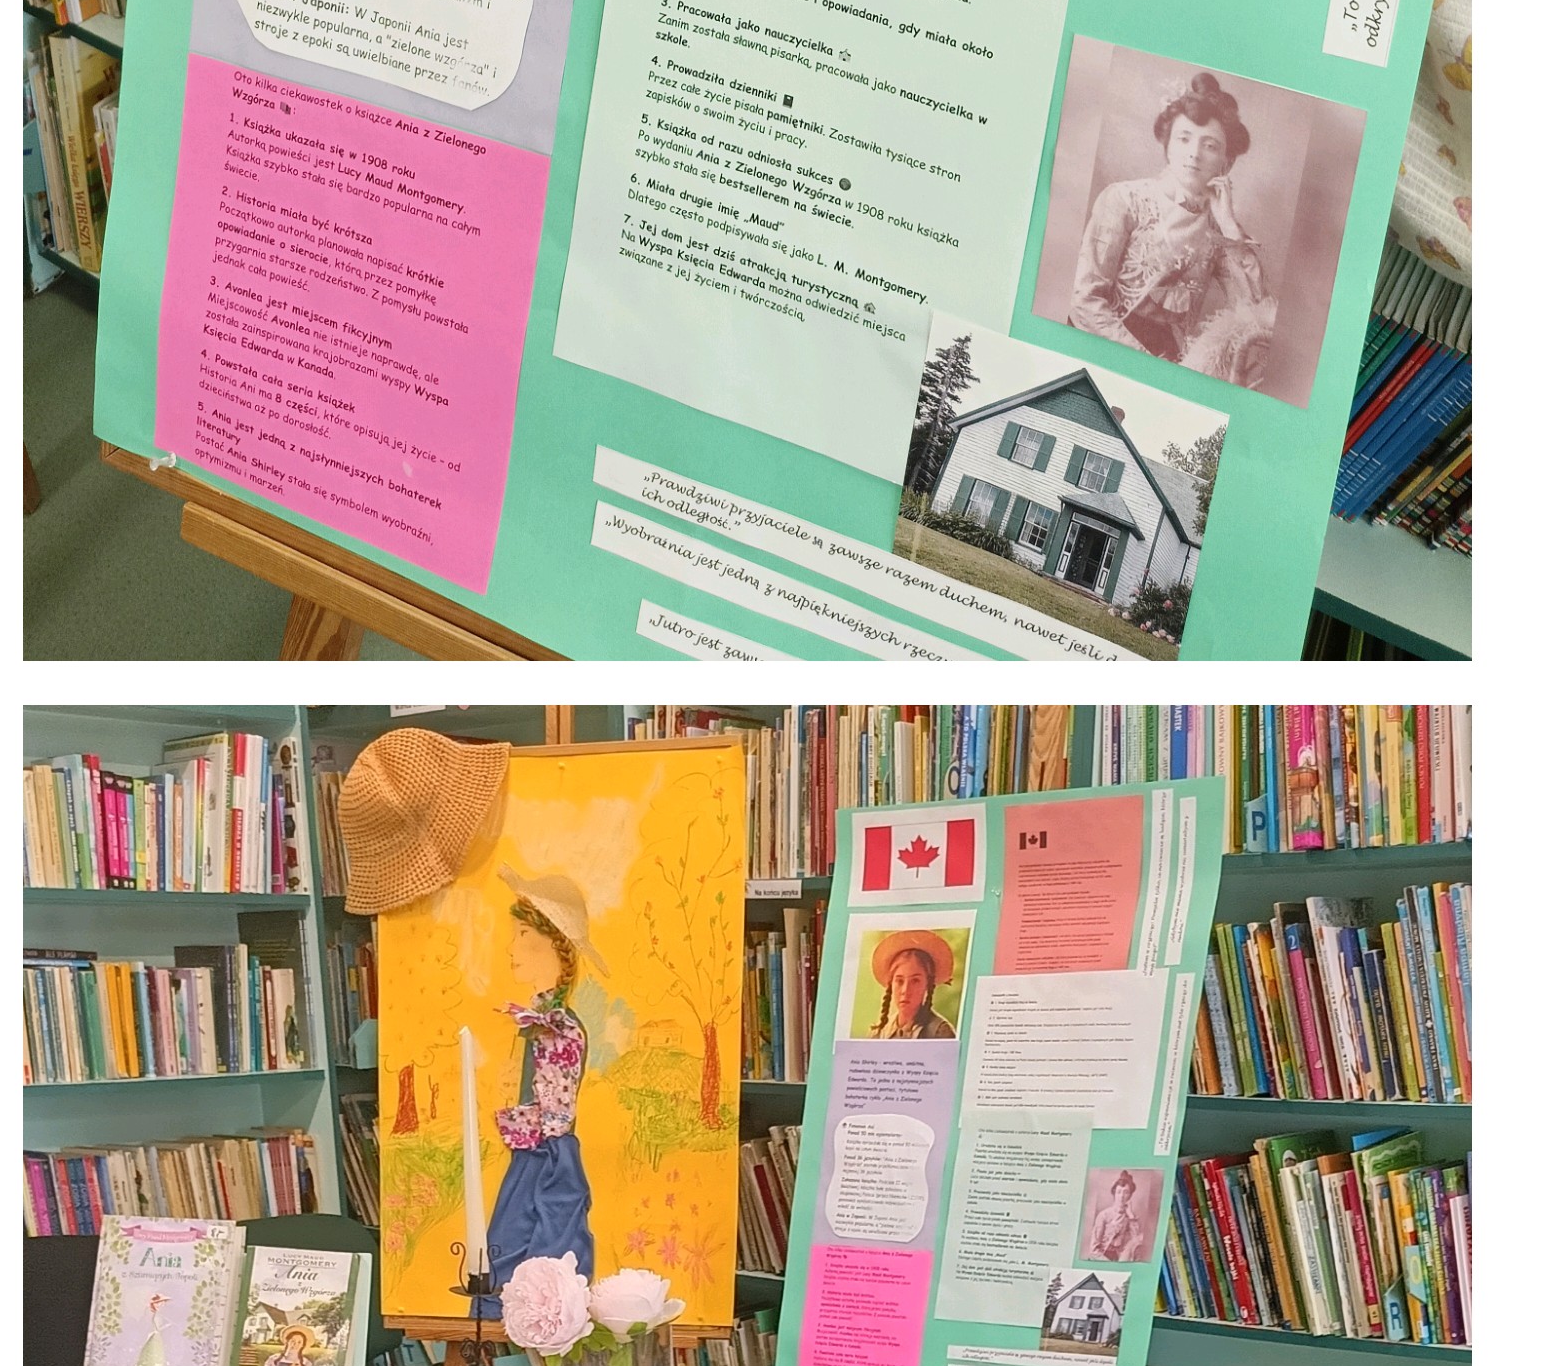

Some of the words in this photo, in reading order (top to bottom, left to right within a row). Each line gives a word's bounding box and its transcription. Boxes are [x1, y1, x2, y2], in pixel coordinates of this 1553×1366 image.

[230, 112, 239, 125] 1.
[243, 116, 281, 138] Książka
[285, 131, 326, 151] ukazała
[329, 144, 345, 158] się
[349, 151, 358, 160] w
[361, 152, 388, 170] 1908
[391, 165, 416, 180] roku
[641, 487, 665, 504] ich
[729, 503, 811, 540] przyjaciele
[812, 535, 824, 549] są
[828, 542, 883, 570] zawsze
[885, 566, 937, 593] razem
[939, 585, 1007, 623] duchem,
[1014, 616, 1067, 645] nawet
[694, 553, 722, 571] jest
[719, 563, 760, 590] jedną
[763, 583, 776, 596] z
[777, 588, 902, 646] najpiękniejszych
[693, 633, 723, 650] jest
[1252, 810, 1266, 841] P
[139, 1247, 183, 1268] Ania
[267, 1257, 337, 1267] MONTGOMERY
[274, 1265, 319, 1281] Ania
[1390, 1302, 1403, 1330] R
